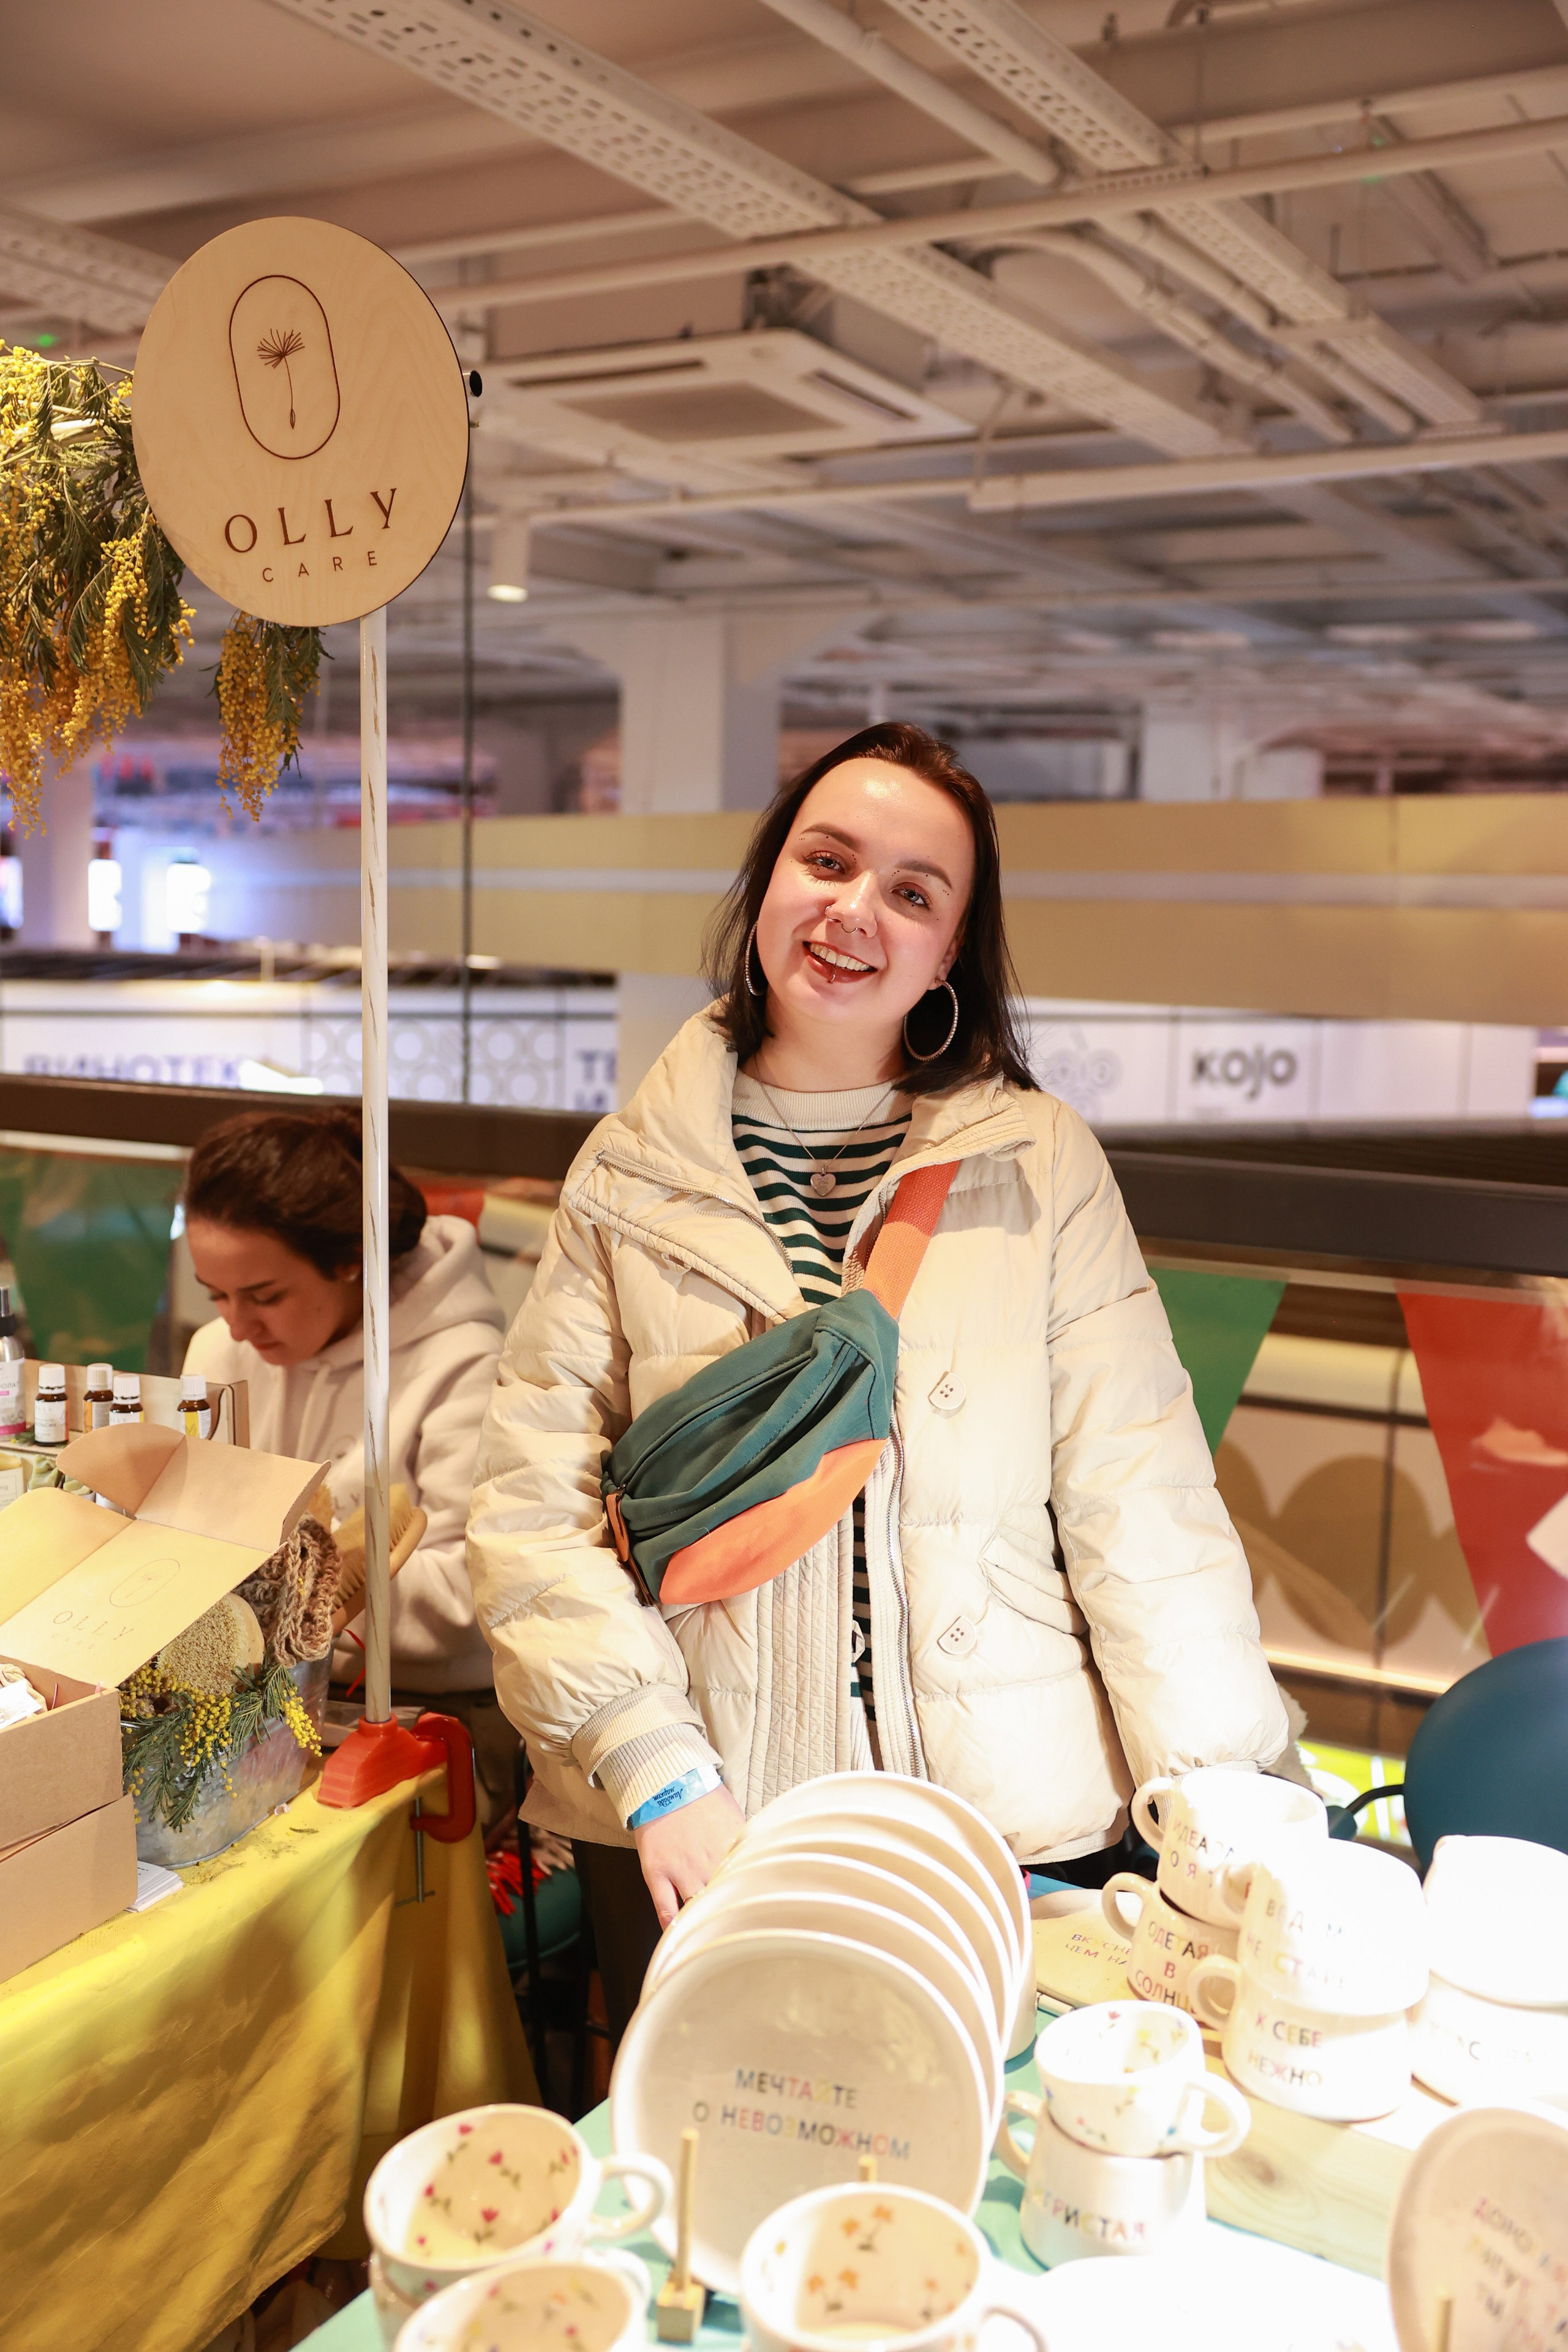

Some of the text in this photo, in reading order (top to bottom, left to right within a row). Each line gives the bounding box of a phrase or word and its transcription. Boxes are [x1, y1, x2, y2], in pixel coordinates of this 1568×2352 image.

[224, 488, 398, 553] OLLY
[262, 551, 378, 582] CARE
[53, 1610, 134, 1641] OLLY
[51, 1633, 96, 1650] CARE
[652, 1786, 674, 1801] маркет
[657, 1789, 684, 1807] Ламбада
[1065, 1943, 1099, 1958] ЧЕМ
[1148, 1921, 1209, 1960] ОДЕТАЯ
[1164, 1961, 1175, 1979] В
[1256, 2011, 1324, 2049] К СЕБЕ
[1247, 2049, 1322, 2087] НЕЖНО
[735, 2068, 858, 2109] МЕЧТАЙТЕ
[692, 2101, 911, 2161] О НЕВОЗМОЖНОМ
